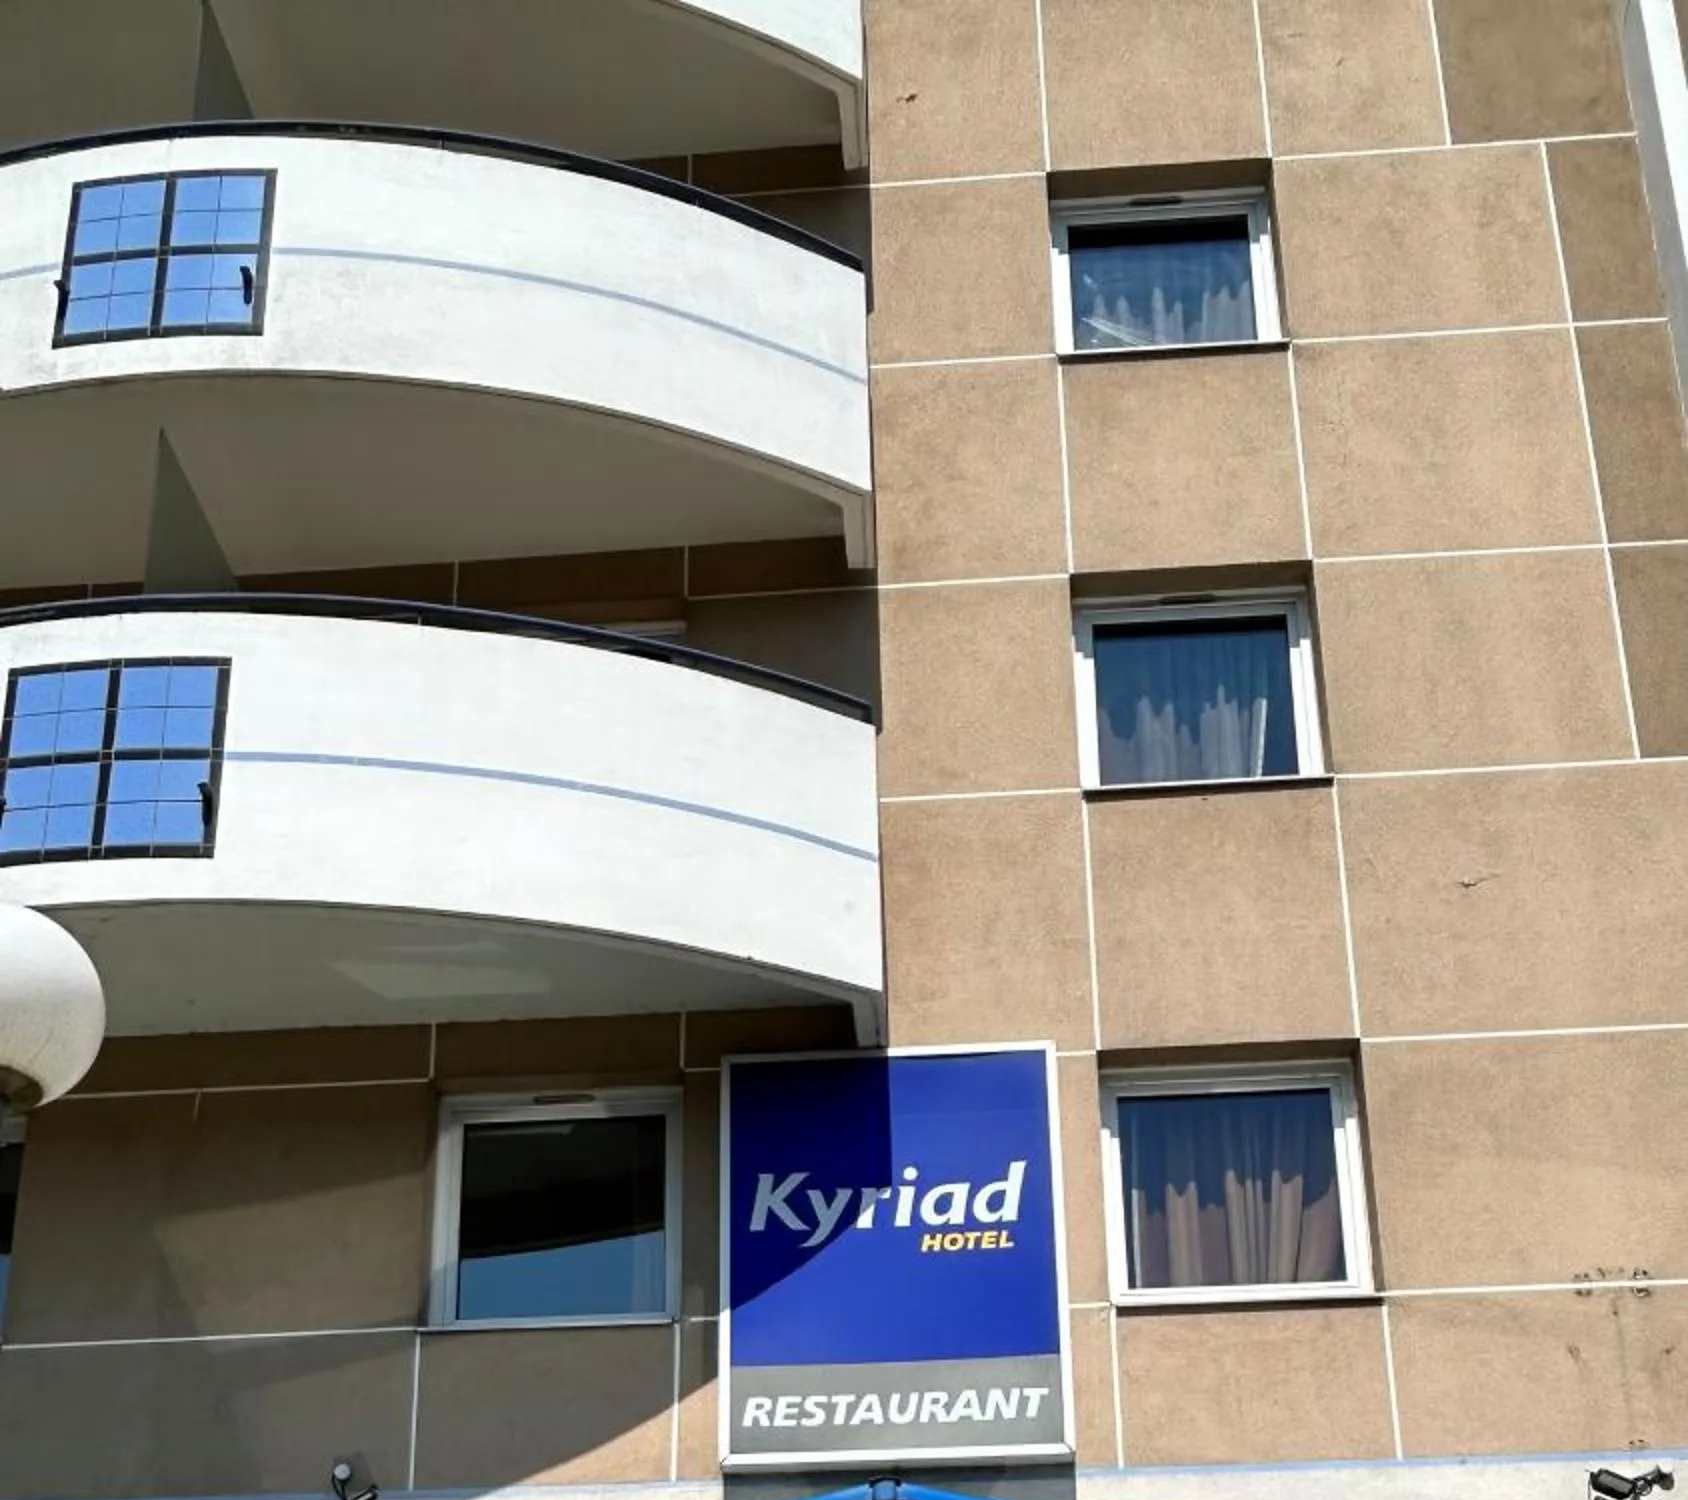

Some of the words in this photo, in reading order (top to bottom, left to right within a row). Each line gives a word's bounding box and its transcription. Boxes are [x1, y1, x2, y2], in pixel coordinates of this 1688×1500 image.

[749, 1160, 1028, 1248] Kyriad
[921, 1231, 1014, 1252] HOTEL
[741, 1387, 1050, 1427] RESTAURANT
